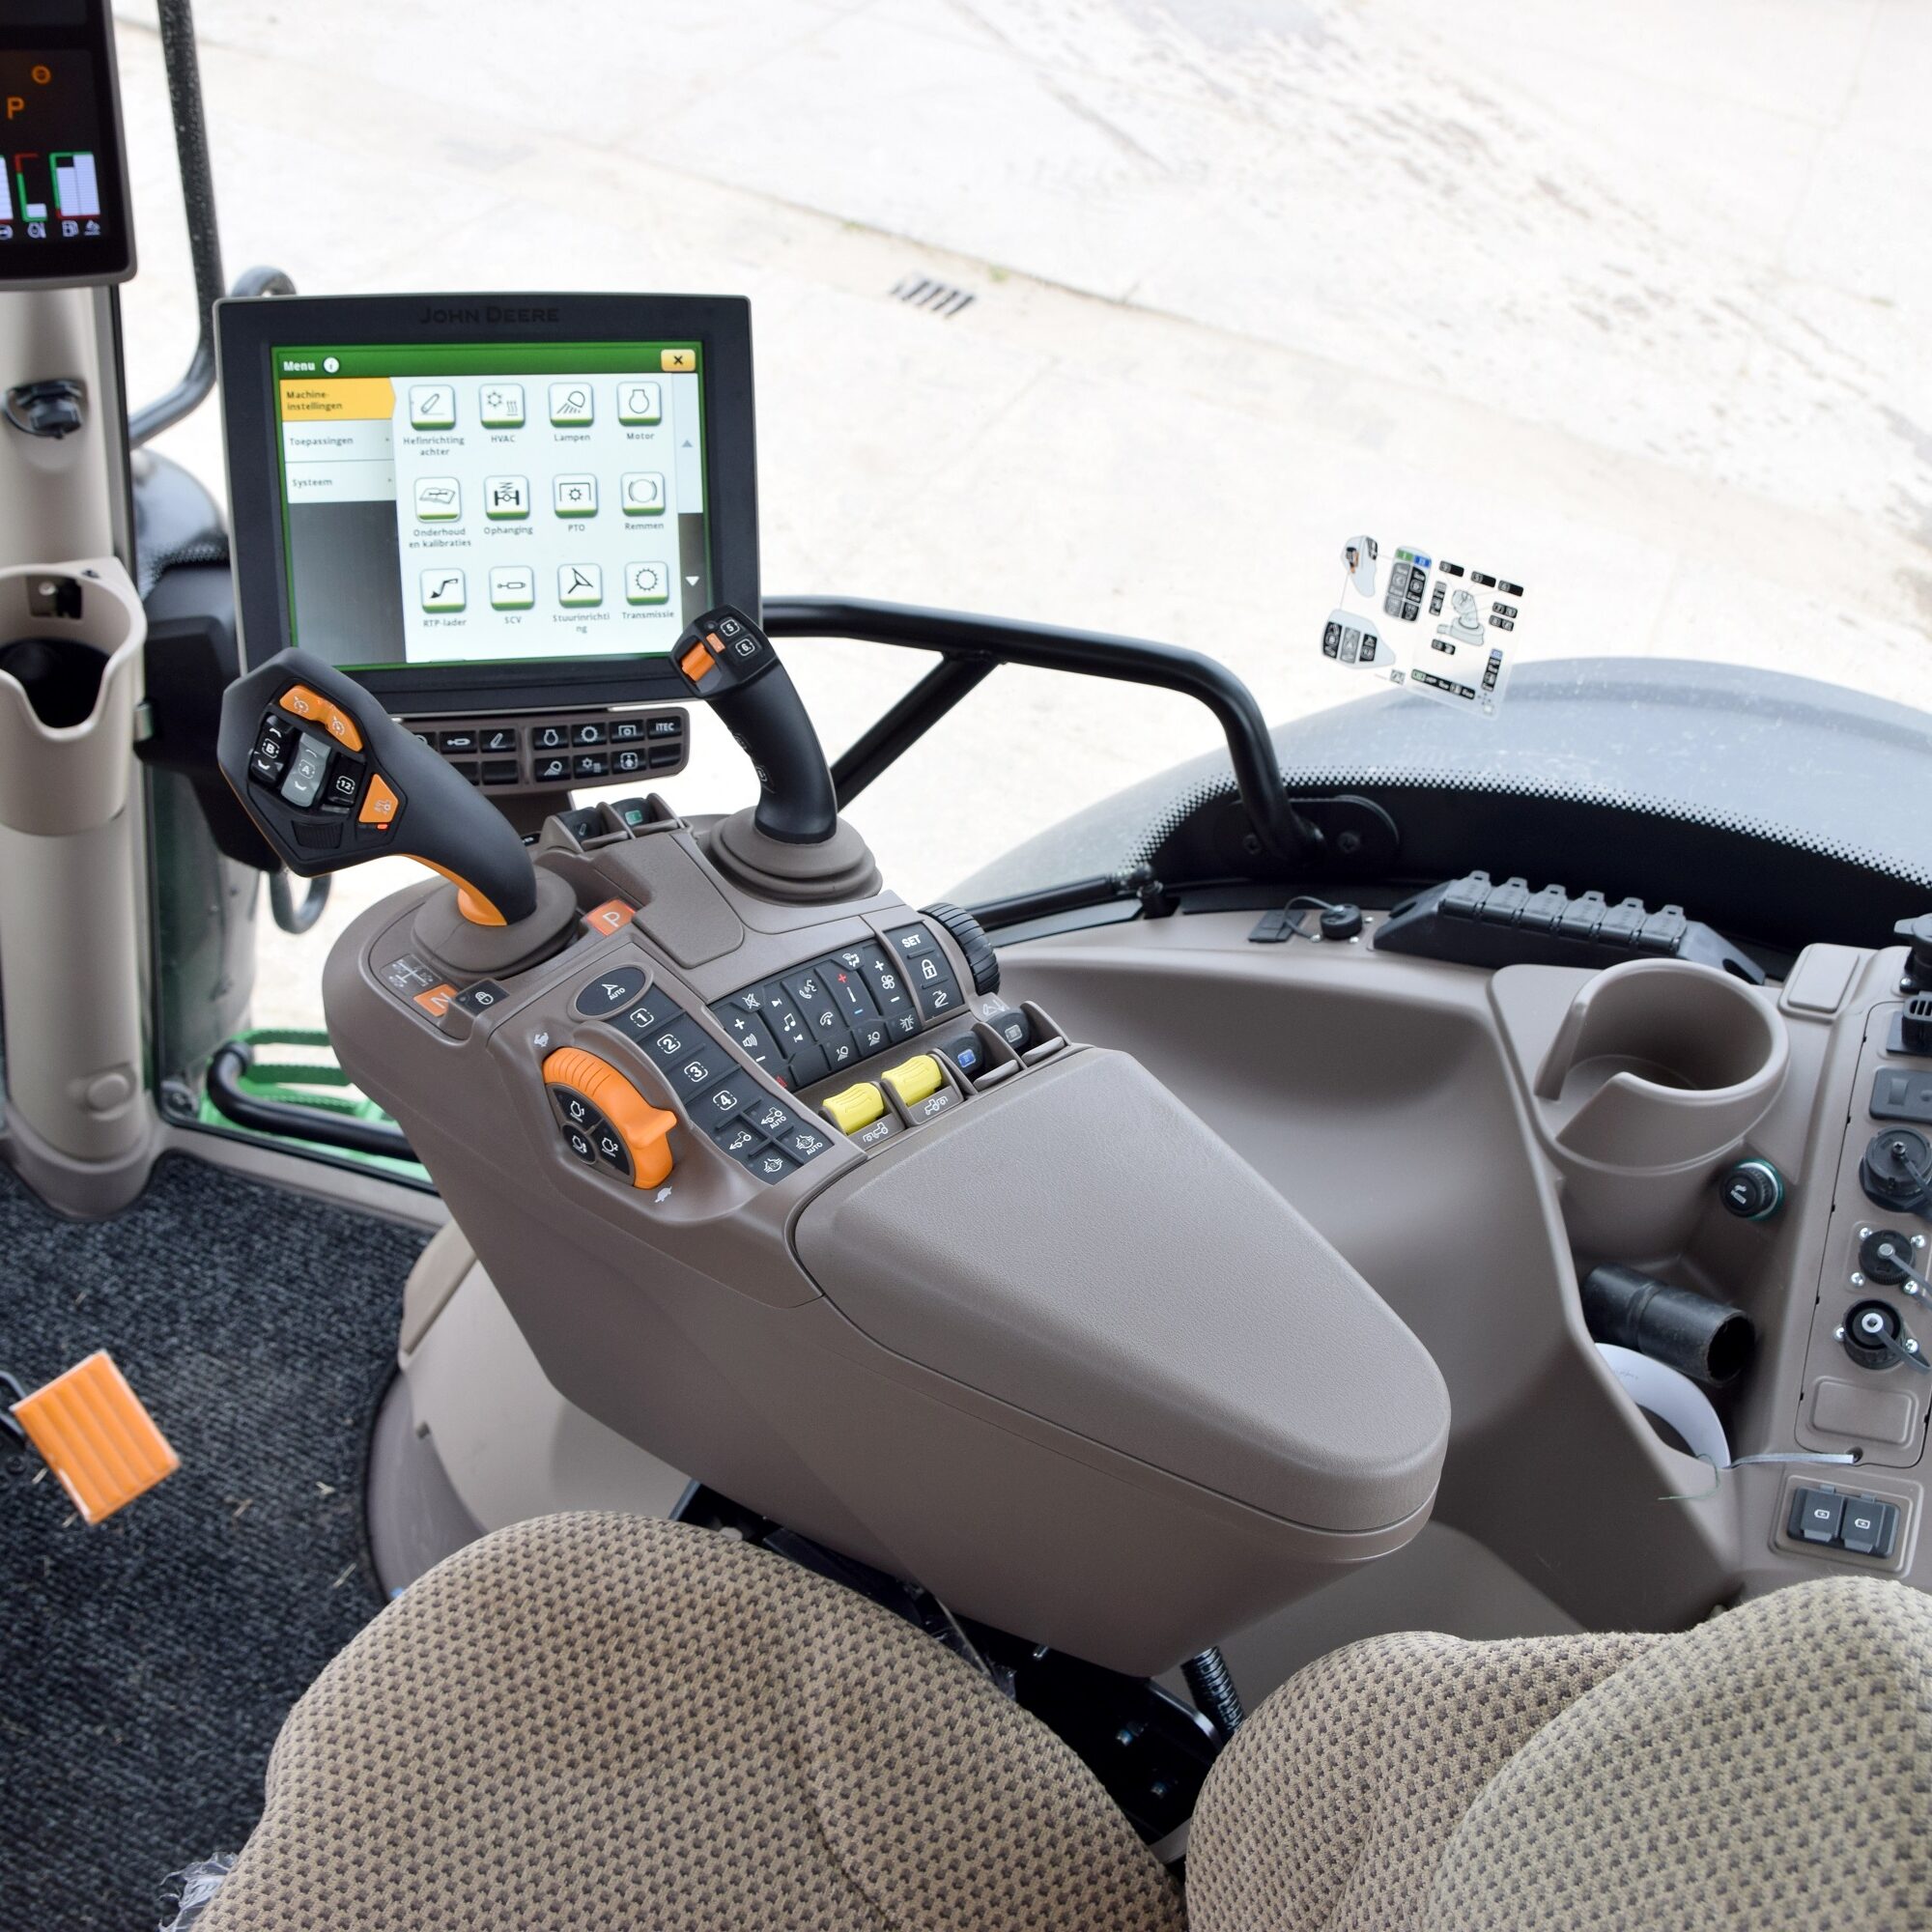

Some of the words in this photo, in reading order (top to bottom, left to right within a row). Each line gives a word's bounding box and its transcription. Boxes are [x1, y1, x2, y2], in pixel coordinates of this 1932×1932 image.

[7, 97, 25, 120] P
[419, 306, 480, 324] JOHN
[486, 306, 559, 323] DEERE
[283, 361, 316, 372] Menu
[287, 402, 343, 412] instellingen
[289, 436, 354, 446] Toepassingen
[403, 436, 466, 446] Hefinrichting
[491, 435, 516, 443] HVAC
[554, 433, 591, 443] Lampen
[626, 432, 655, 440] Motor
[420, 447, 450, 456] achter
[292, 477, 333, 488] Systeem
[484, 526, 533, 536] Ophanging
[568, 524, 585, 532] PTO
[624, 522, 665, 530] Remmen
[413, 527, 466, 537] Onderhoud
[422, 539, 471, 548] kalibraties
[504, 615, 523, 624] SCV
[553, 612, 611, 623] Stuurinrichti
[622, 611, 674, 620] Transmissie
[424, 618, 467, 627] RTP-lader
[576, 625, 588, 634] ng
[340, 780, 353, 790] 12
[602, 911, 620, 927] P
[901, 934, 922, 948] SET
[609, 987, 626, 1001] AUTO
[430, 991, 451, 1009] N
[770, 1116, 786, 1129] AUTO
[806, 1142, 823, 1155] AUTO
